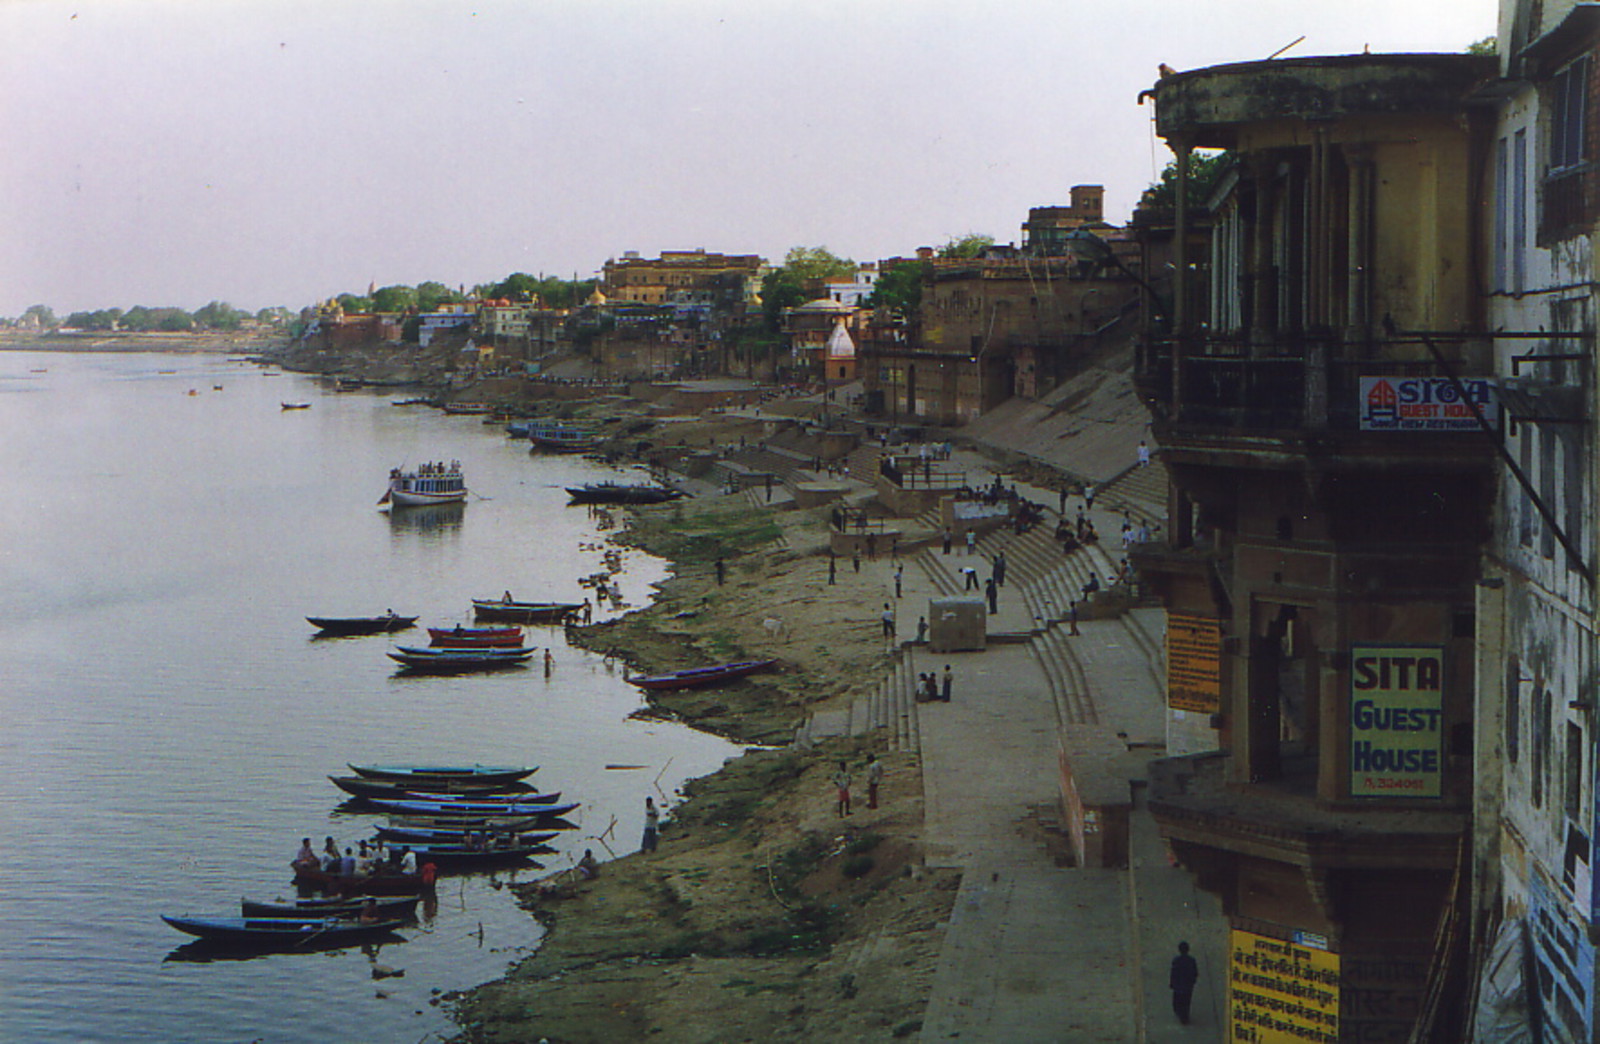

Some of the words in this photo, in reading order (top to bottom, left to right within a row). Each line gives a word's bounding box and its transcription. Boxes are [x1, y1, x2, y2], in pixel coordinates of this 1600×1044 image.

[1399, 379, 1490, 403] SITA
[1400, 404, 1440, 418] GUEST
[1354, 657, 1440, 690] SITA
[1354, 700, 1442, 732] GUEST
[1354, 740, 1438, 773] HOUSE
